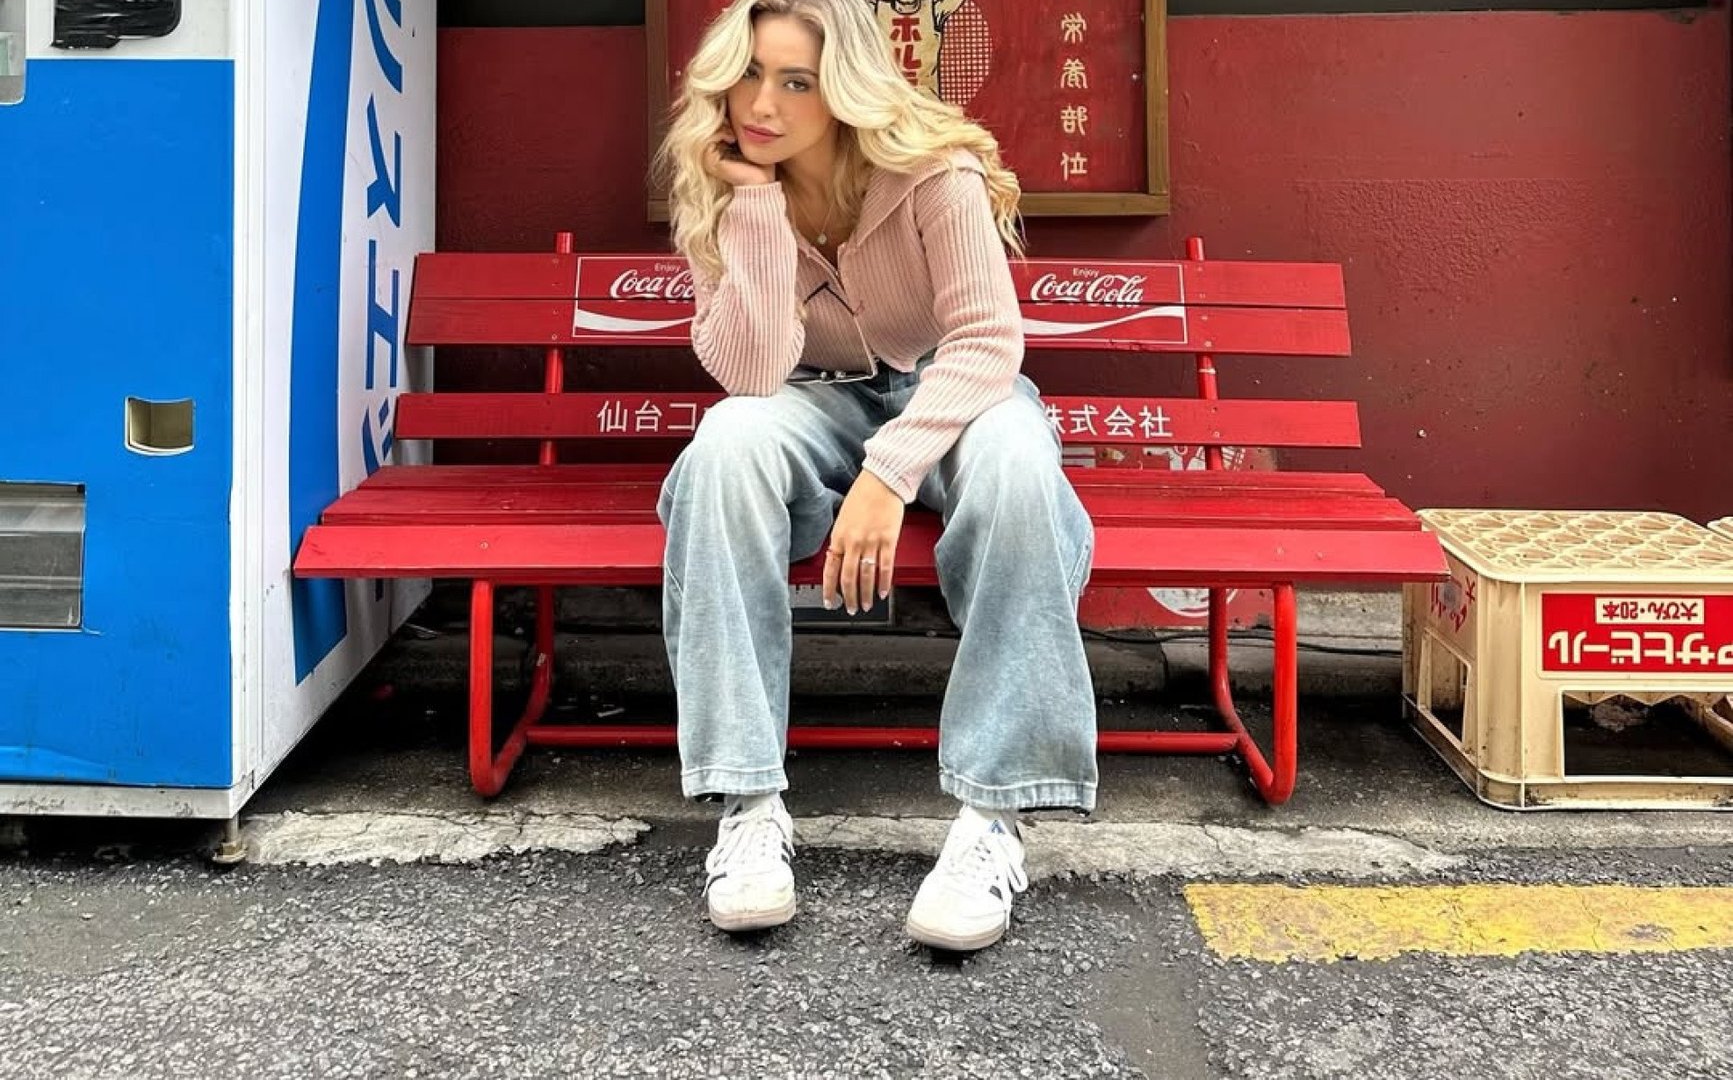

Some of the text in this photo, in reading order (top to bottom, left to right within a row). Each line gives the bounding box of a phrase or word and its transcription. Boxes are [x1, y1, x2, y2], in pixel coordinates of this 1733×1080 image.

[654, 262, 681, 272] Enjoy
[1073, 267, 1100, 278] Enjoy
[1030, 273, 1148, 308] Coca-Cola
[597, 400, 707, 432] 仙台コ
